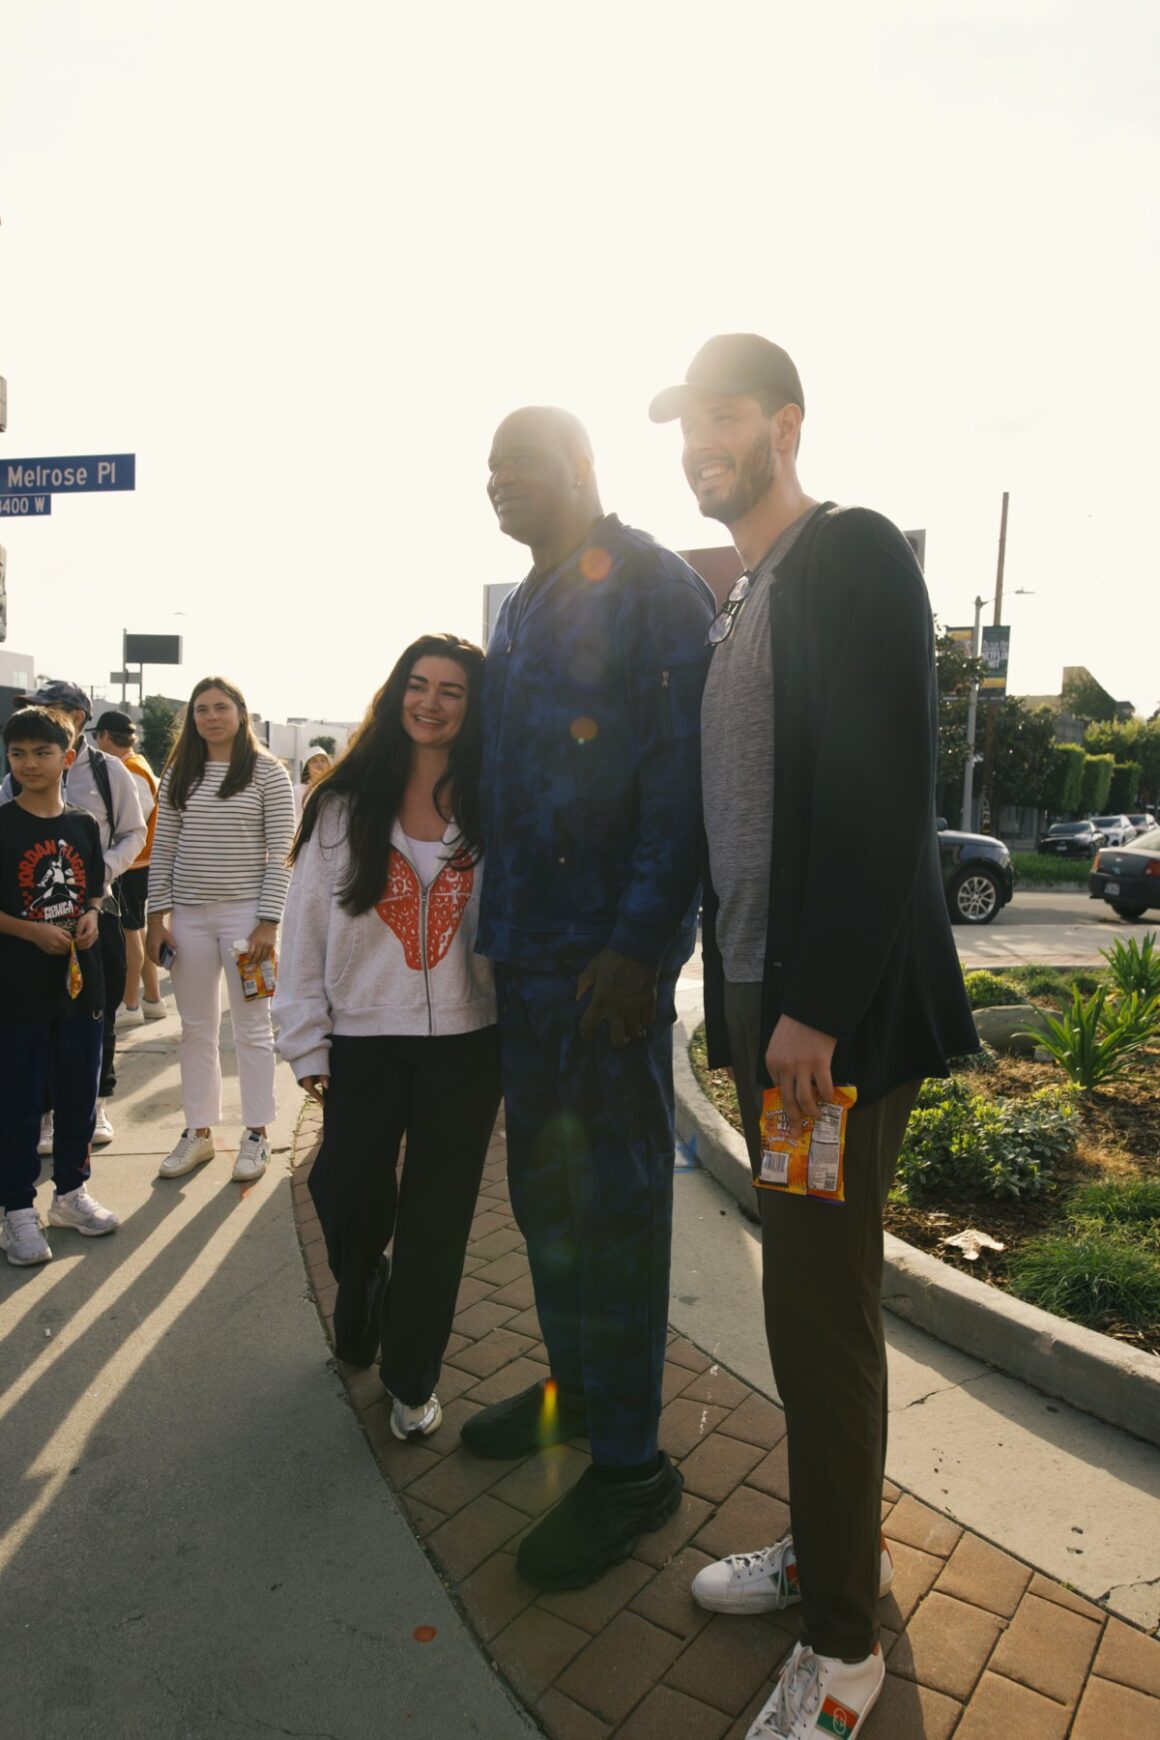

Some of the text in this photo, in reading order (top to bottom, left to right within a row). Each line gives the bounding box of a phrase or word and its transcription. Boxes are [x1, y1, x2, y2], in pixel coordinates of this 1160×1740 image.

[8, 462, 116, 488] Melrose Pl
[34, 497, 46, 513] W
[18, 839, 86, 888] JORDAN FLIGHT
